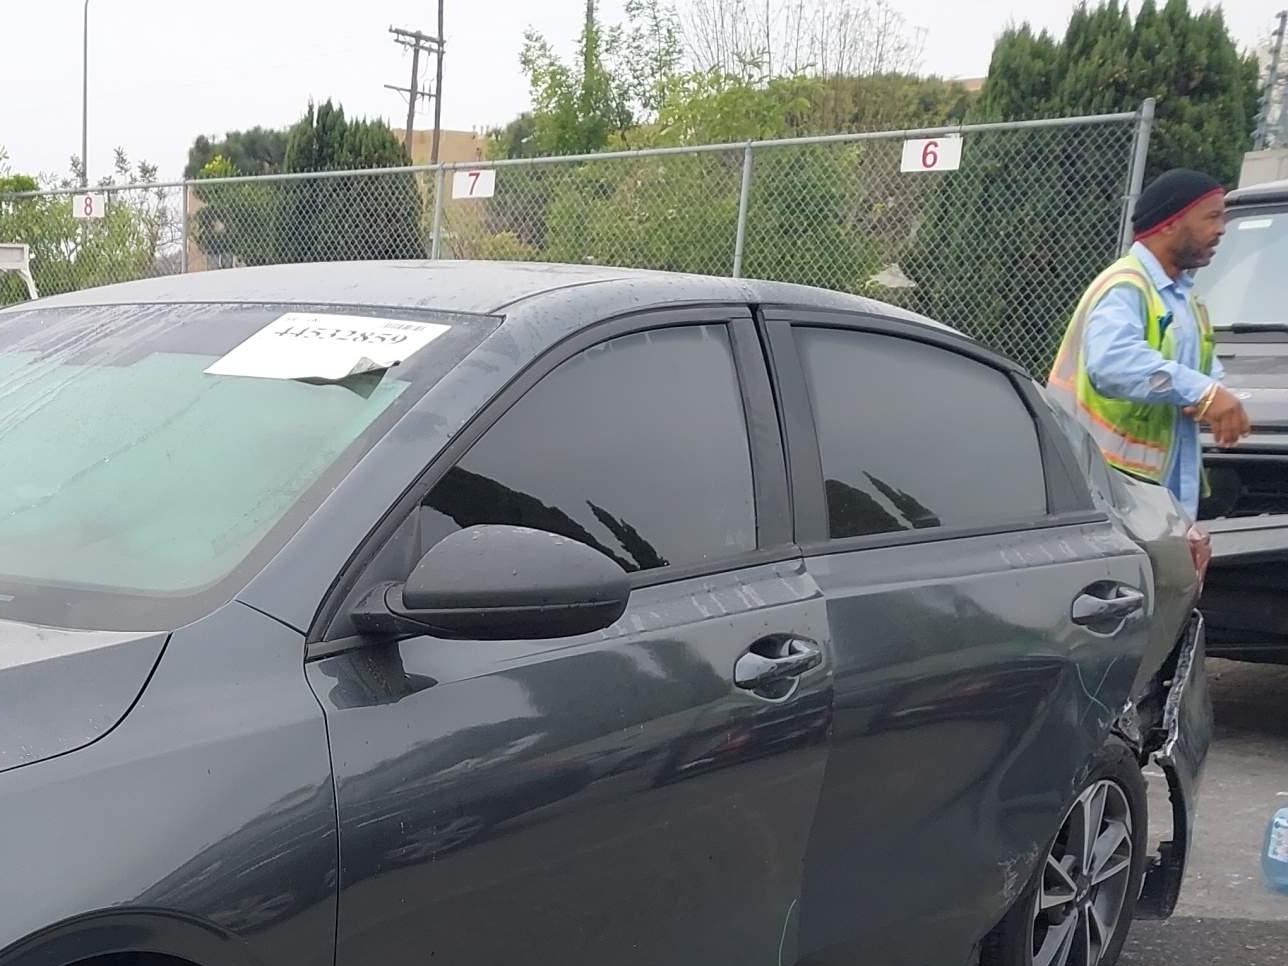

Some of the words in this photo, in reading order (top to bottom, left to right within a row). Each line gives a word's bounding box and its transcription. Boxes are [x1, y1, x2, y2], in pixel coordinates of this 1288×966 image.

[921, 141, 939, 169] 6
[467, 172, 481, 196] 7
[84, 196, 93, 216] 8
[274, 326, 408, 345] 44532859
